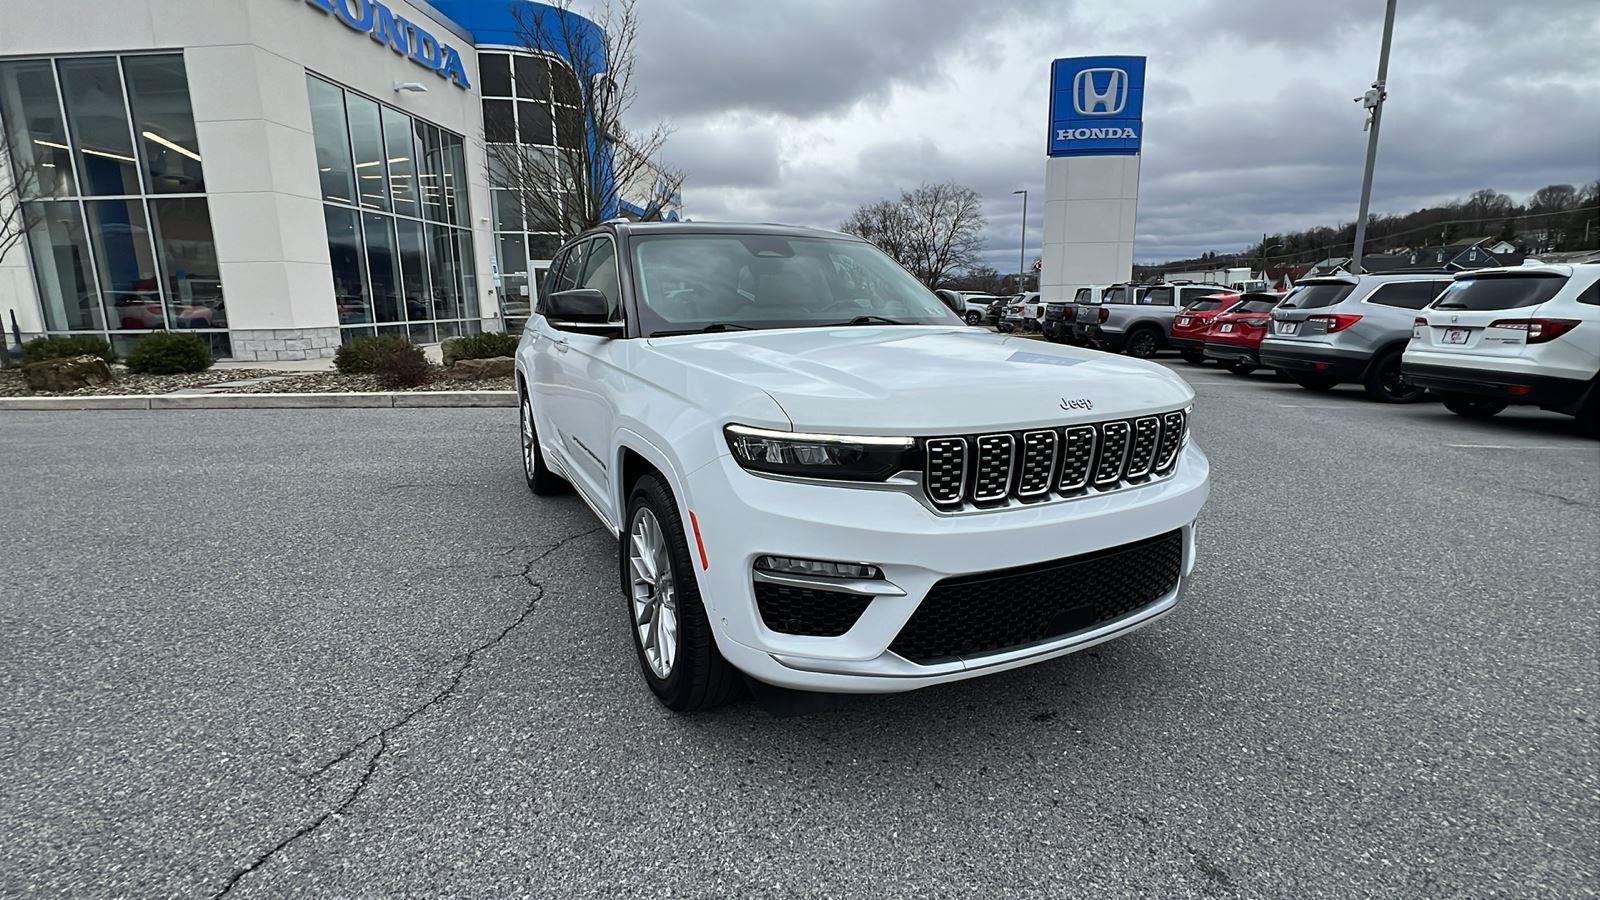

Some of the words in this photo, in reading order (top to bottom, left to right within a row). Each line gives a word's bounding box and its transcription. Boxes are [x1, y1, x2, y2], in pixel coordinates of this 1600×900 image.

[304, 0, 471, 90] ONDA
[1057, 128, 1137, 140] HONDA
[1060, 397, 1094, 410] Jeep
